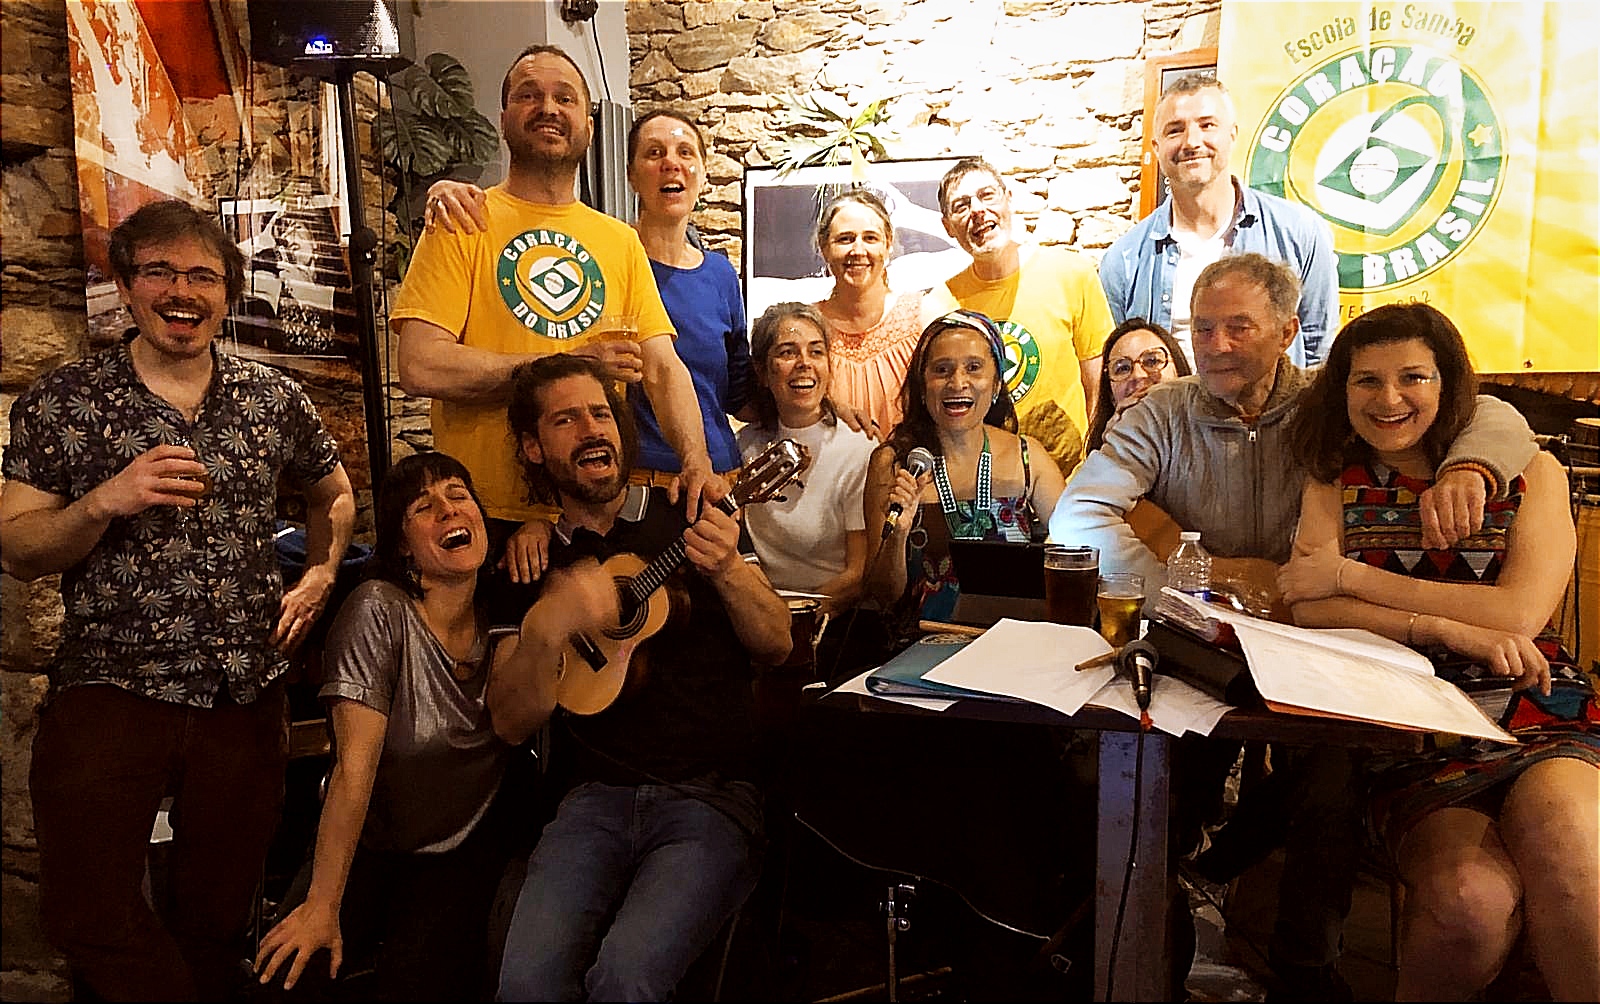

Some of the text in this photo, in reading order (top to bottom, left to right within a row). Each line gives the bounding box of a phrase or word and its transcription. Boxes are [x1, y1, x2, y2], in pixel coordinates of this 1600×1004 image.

[1368, 6, 1392, 31] de
[1401, 3, 1476, 46] Samba
[304, 41, 333, 54] ALTO
[1362, 177, 1495, 288] BRASIL
[512, 300, 603, 339] DO BRASIL
